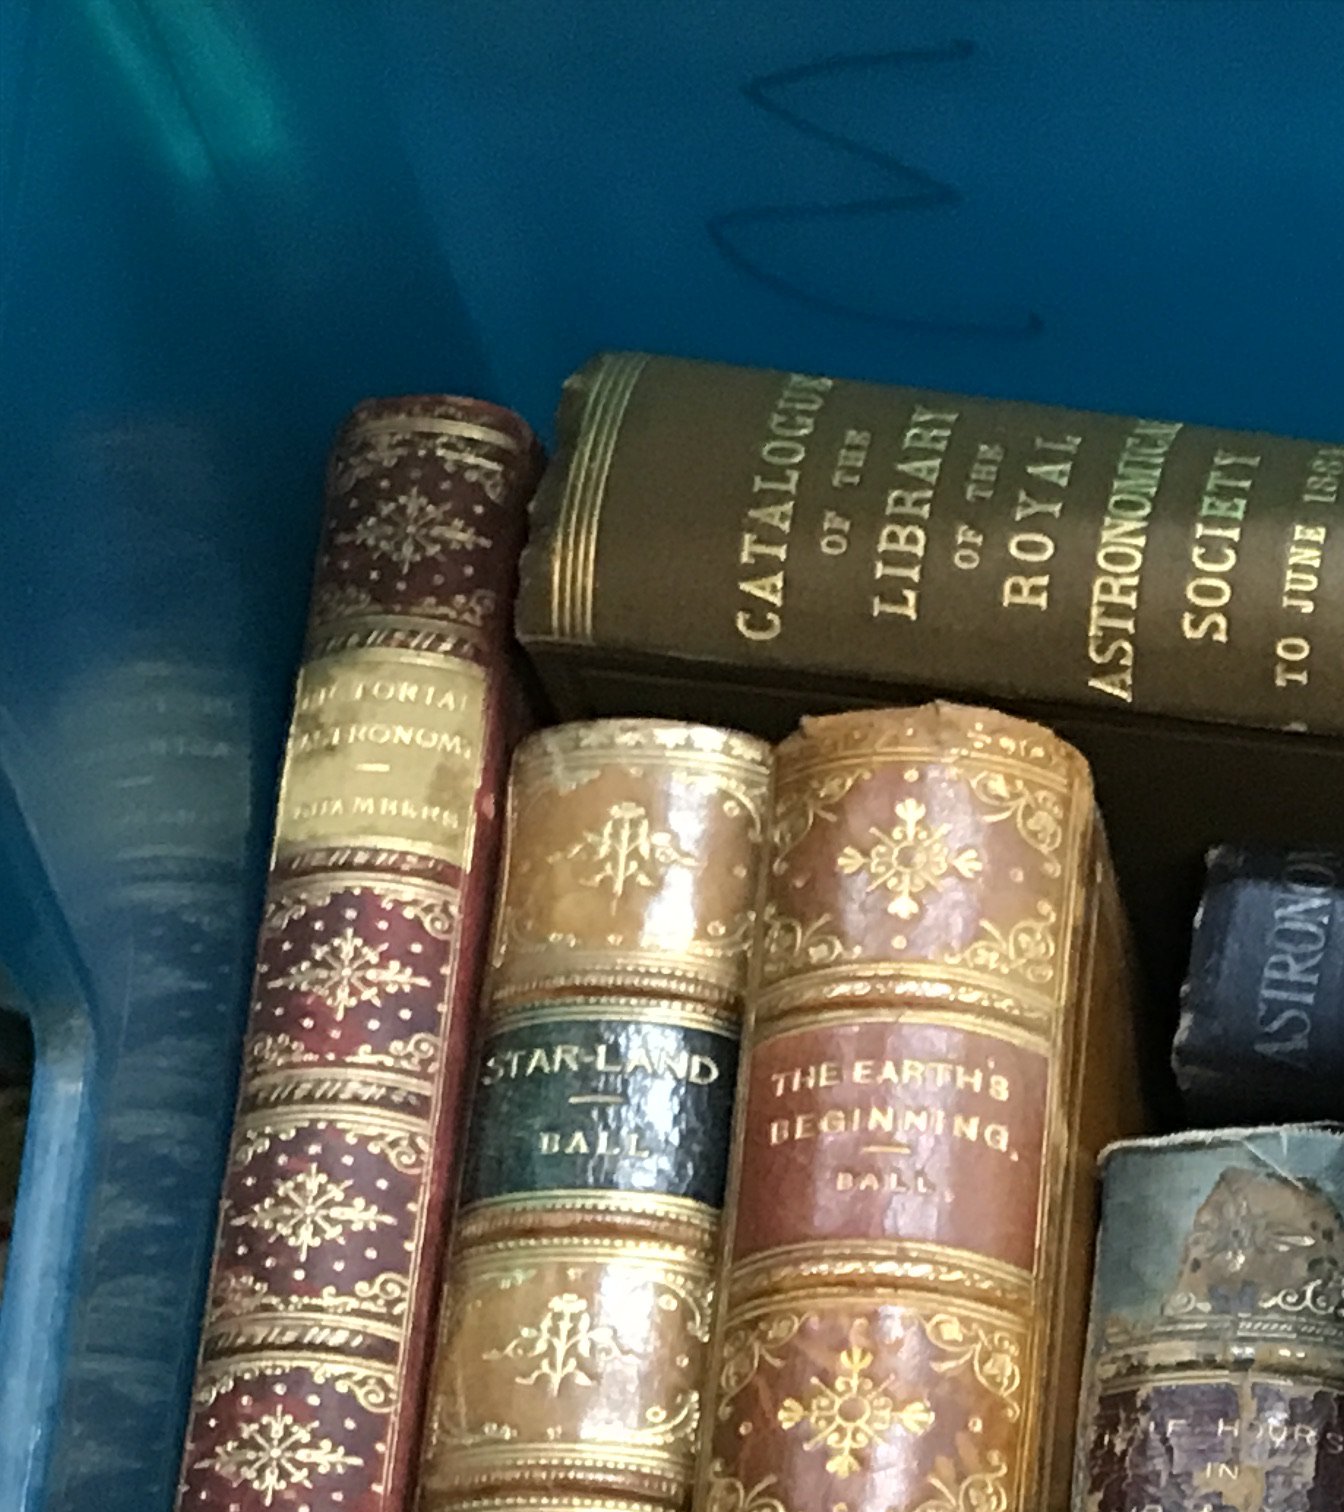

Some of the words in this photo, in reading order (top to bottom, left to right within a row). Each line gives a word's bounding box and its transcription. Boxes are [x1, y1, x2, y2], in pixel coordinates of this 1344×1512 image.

[831, 428, 872, 488] THE
[965, 443, 1005, 501] THE
[820, 509, 850, 556] OF
[872, 404, 960, 622] LIBRARY
[1002, 435, 1083, 612] ROYAL
[953, 523, 984, 570] OF
[1180, 449, 1262, 644] SOCIETY
[1281, 523, 1327, 614] JUNE
[1274, 636, 1311, 688] TO
[481, 1043, 720, 1086] STAR-LAND
[770, 1061, 842, 1097] THE
[538, 1131, 650, 1159] BALL
[1205, 1461, 1240, 1481] IN
